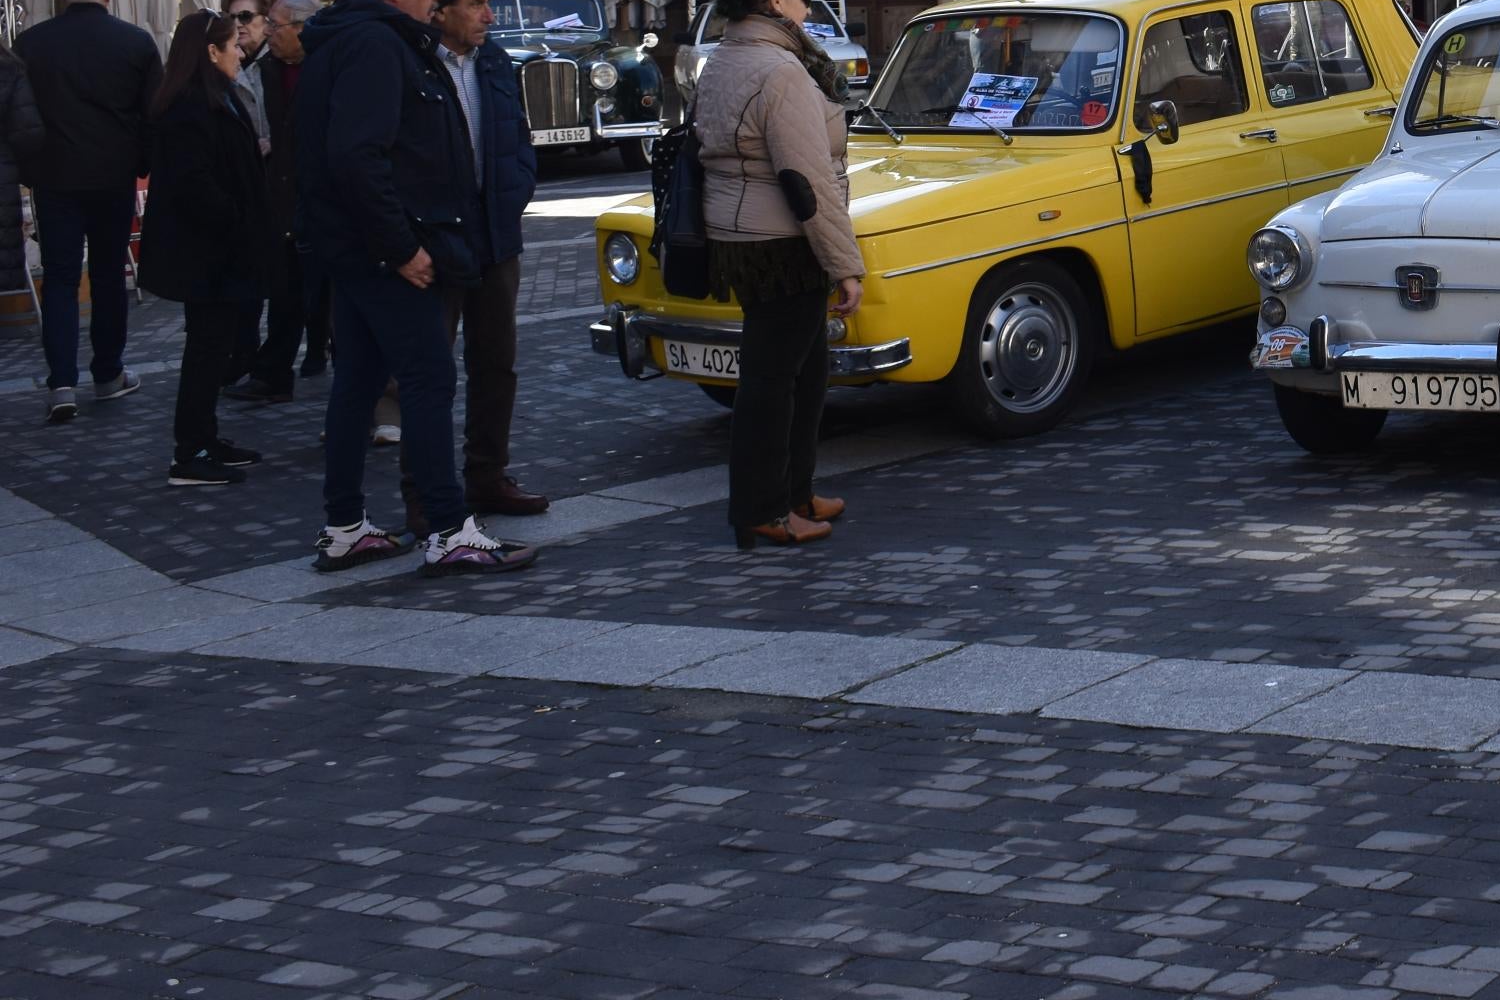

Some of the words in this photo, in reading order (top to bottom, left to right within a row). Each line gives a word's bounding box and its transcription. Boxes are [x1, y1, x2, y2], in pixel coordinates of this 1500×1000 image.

[1447, 36, 1463, 52] H
[1089, 103, 1101, 114] 17
[1270, 338, 1286, 351] 08
